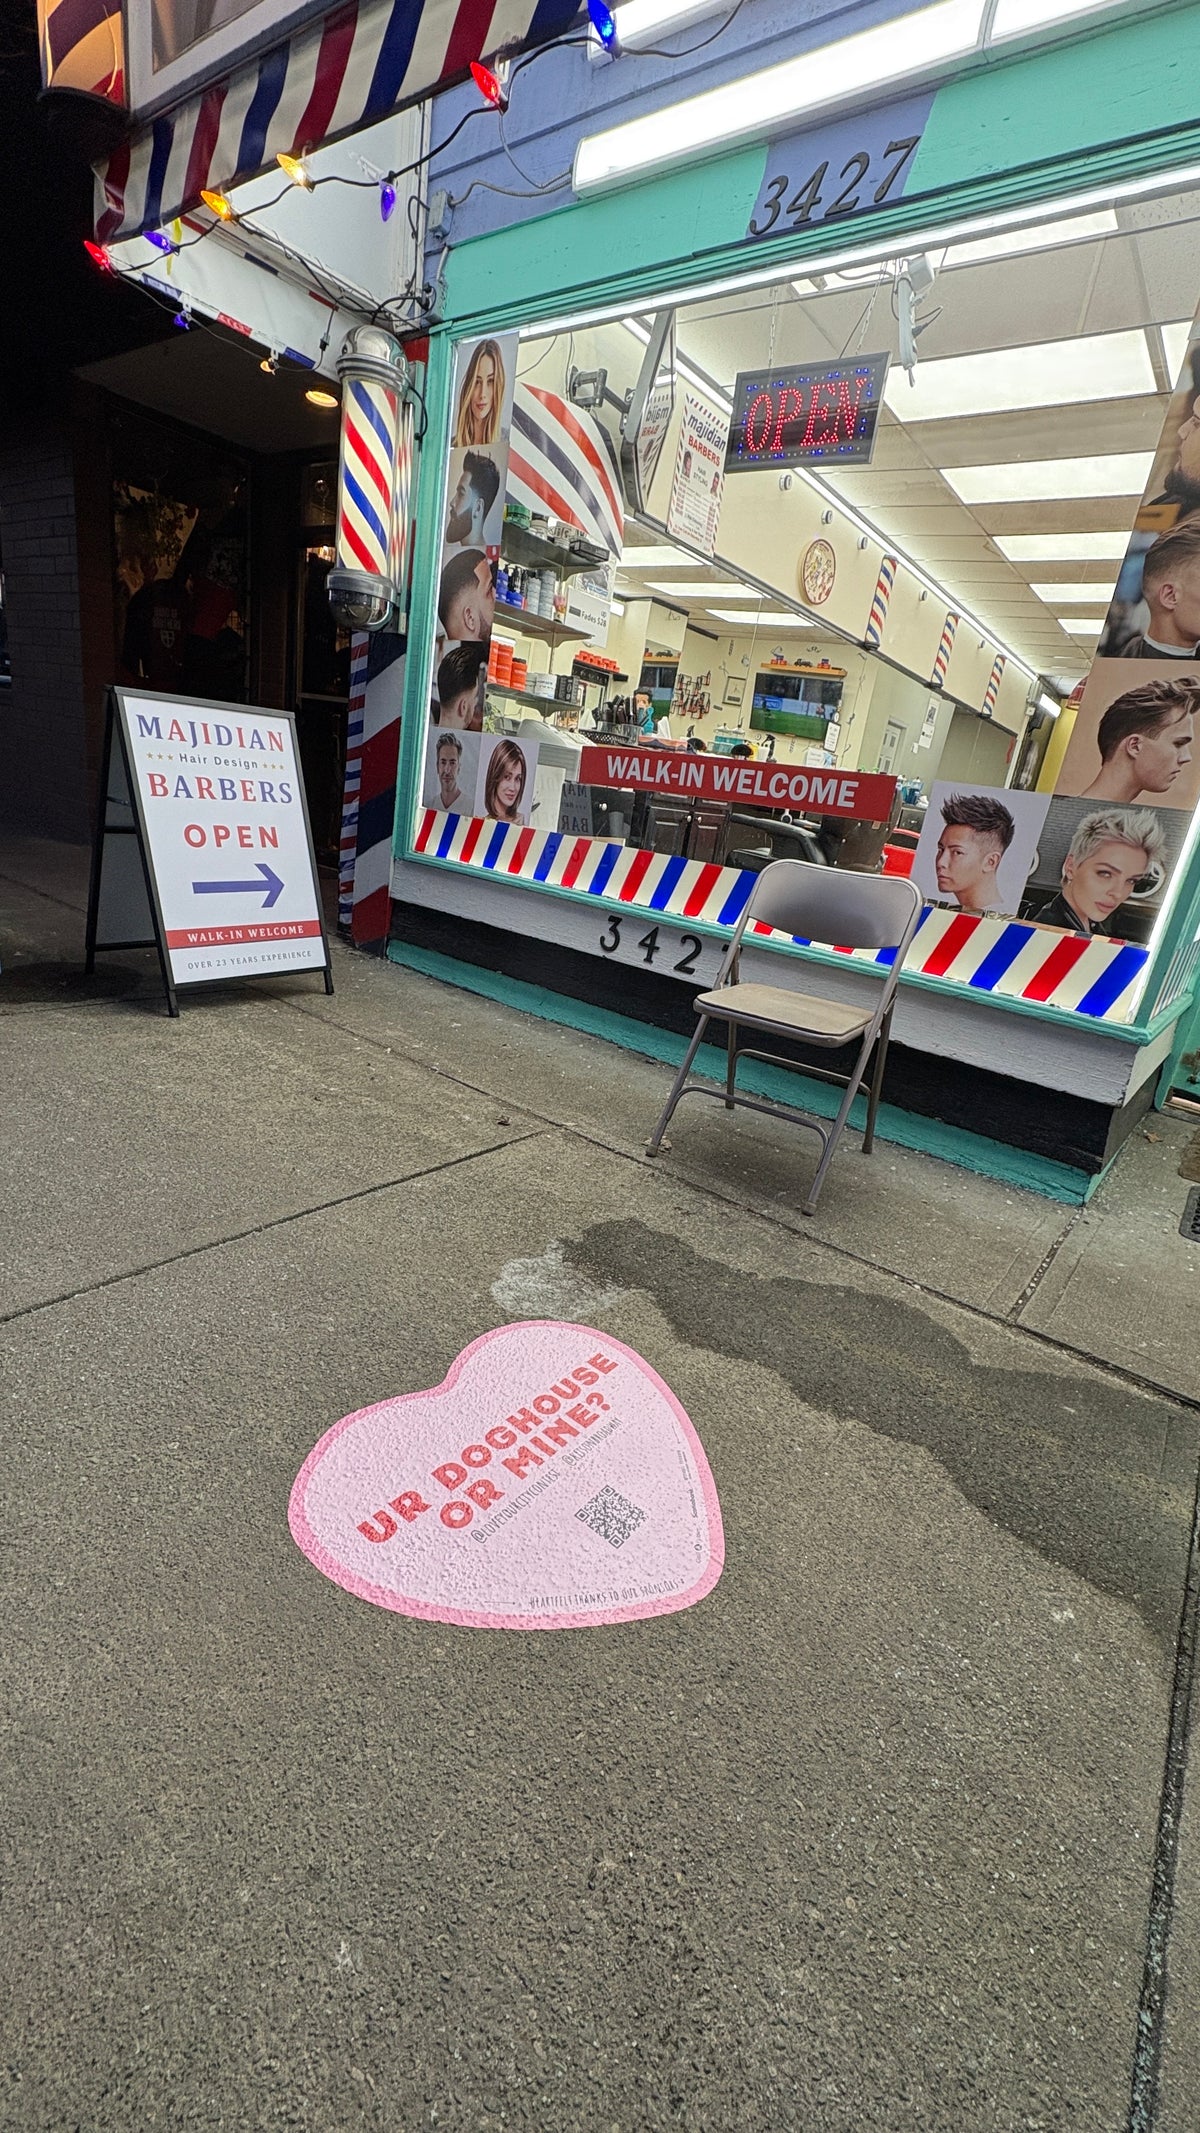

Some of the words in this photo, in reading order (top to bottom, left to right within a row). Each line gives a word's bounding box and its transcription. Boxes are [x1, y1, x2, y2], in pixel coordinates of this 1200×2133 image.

[750, 135, 921, 235] 3427
[746, 378, 867, 452] OPEN
[687, 414, 726, 452] majidian
[688, 435, 720, 467] BARBERS
[582, 611, 596, 624] Fades
[136, 714, 284, 752] MAJIDIAN
[179, 753, 208, 765] Hair
[214, 756, 258, 770] Design
[147, 773, 293, 804] BARBERS
[607, 755, 705, 788] WALK-IN
[712, 765, 860, 809] WELCOME
[184, 824, 279, 848] OPEN
[187, 929, 243, 943] WALK-IN
[247, 925, 304, 938] WELCOME
[187, 961, 213, 970] OVER
[216, 959, 227, 967] 23
[230, 956, 258, 965] YEARS
[261, 951, 312, 962] EXPERIENCE
[356, 1490, 432, 1544] UR
[431, 1352, 618, 1491] DOGHOUSE
[440, 1479, 505, 1529] OR
[501, 1392, 611, 1480] MINE?
[470, 1468, 560, 1544] @LOVEYOURCITYCONTEST
[574, 1591, 606, 1605] THANKS
[609, 1589, 619, 1601] TO
[621, 1586, 638, 1599] OUR
